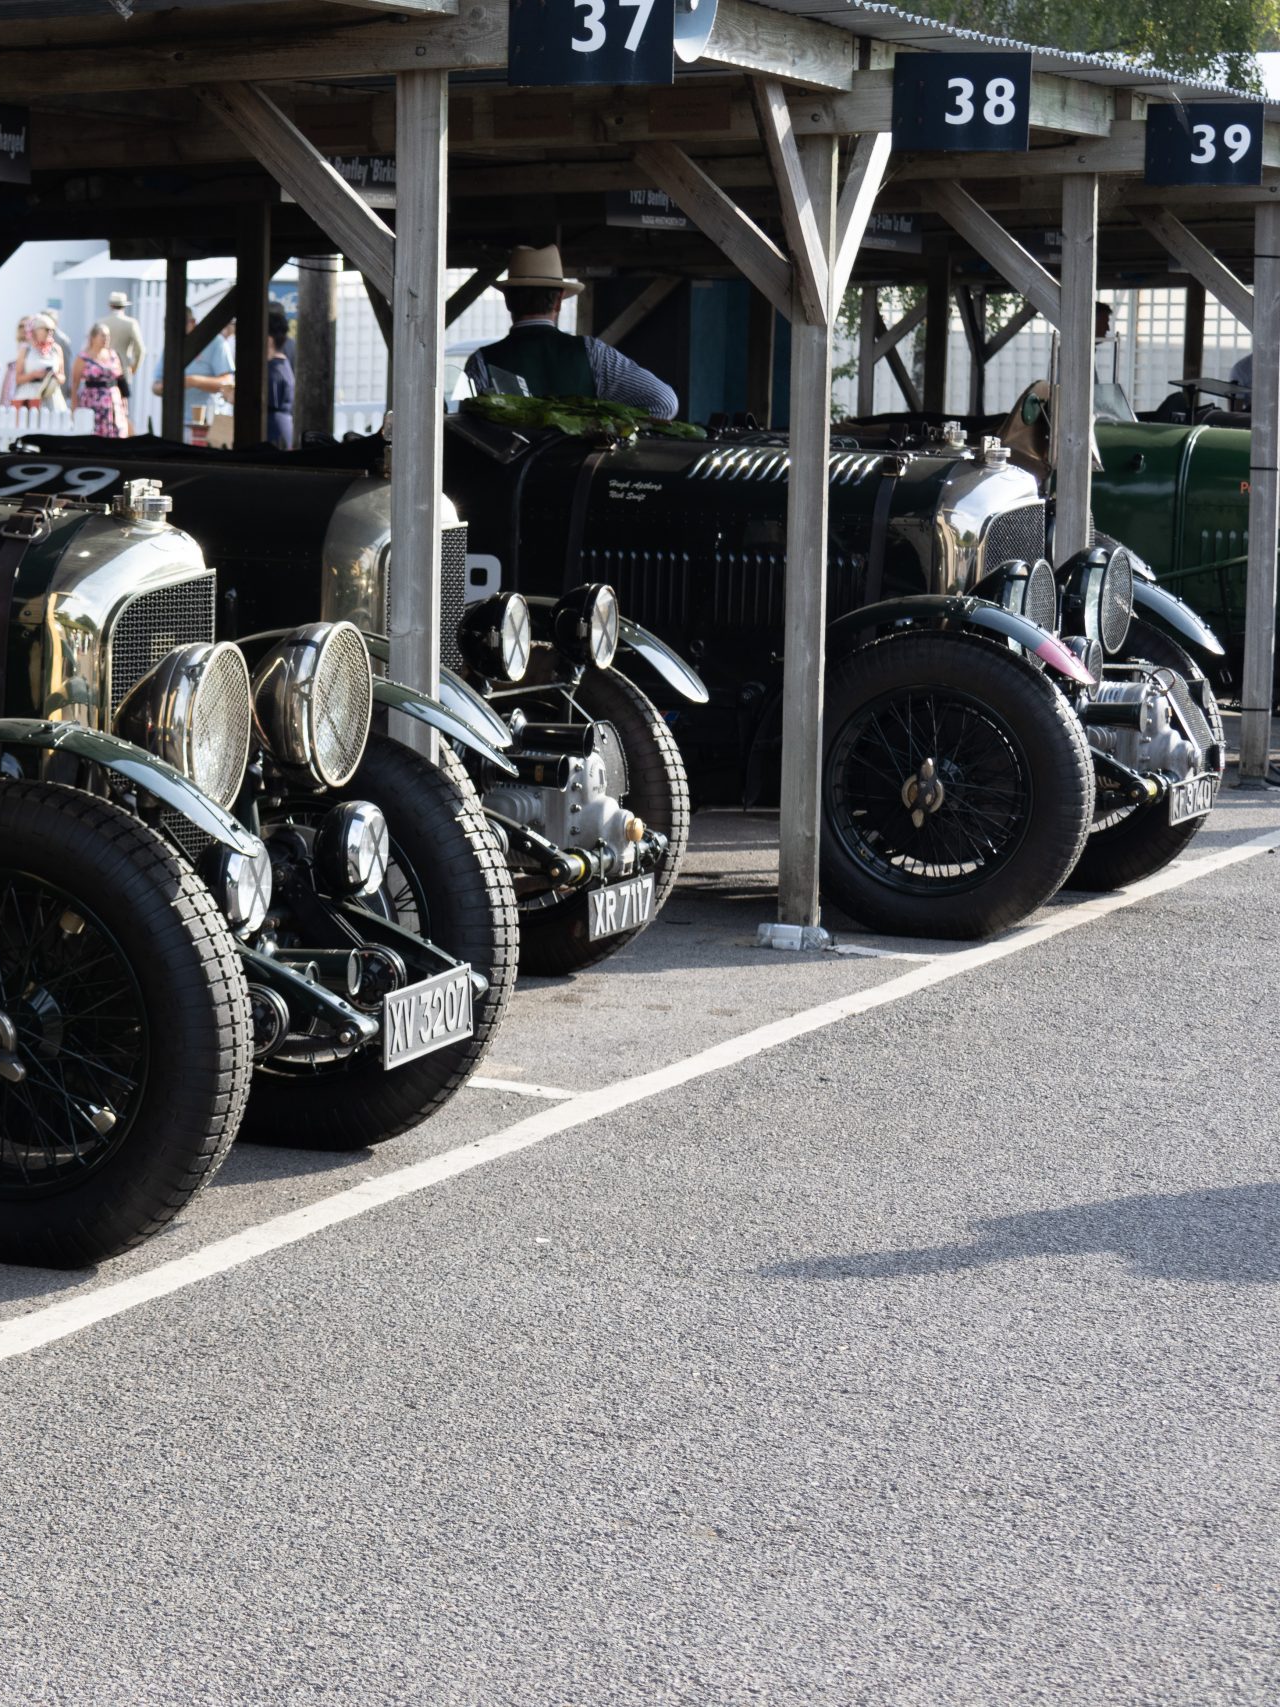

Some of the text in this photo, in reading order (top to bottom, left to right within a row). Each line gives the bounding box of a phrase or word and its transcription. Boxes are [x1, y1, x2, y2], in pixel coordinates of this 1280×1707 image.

[571, 0, 656, 52] 37
[945, 77, 1016, 125] 38
[1190, 124, 1251, 164] 39
[593, 878, 653, 937] XR 7117
[389, 975, 468, 1055] XV 3207
